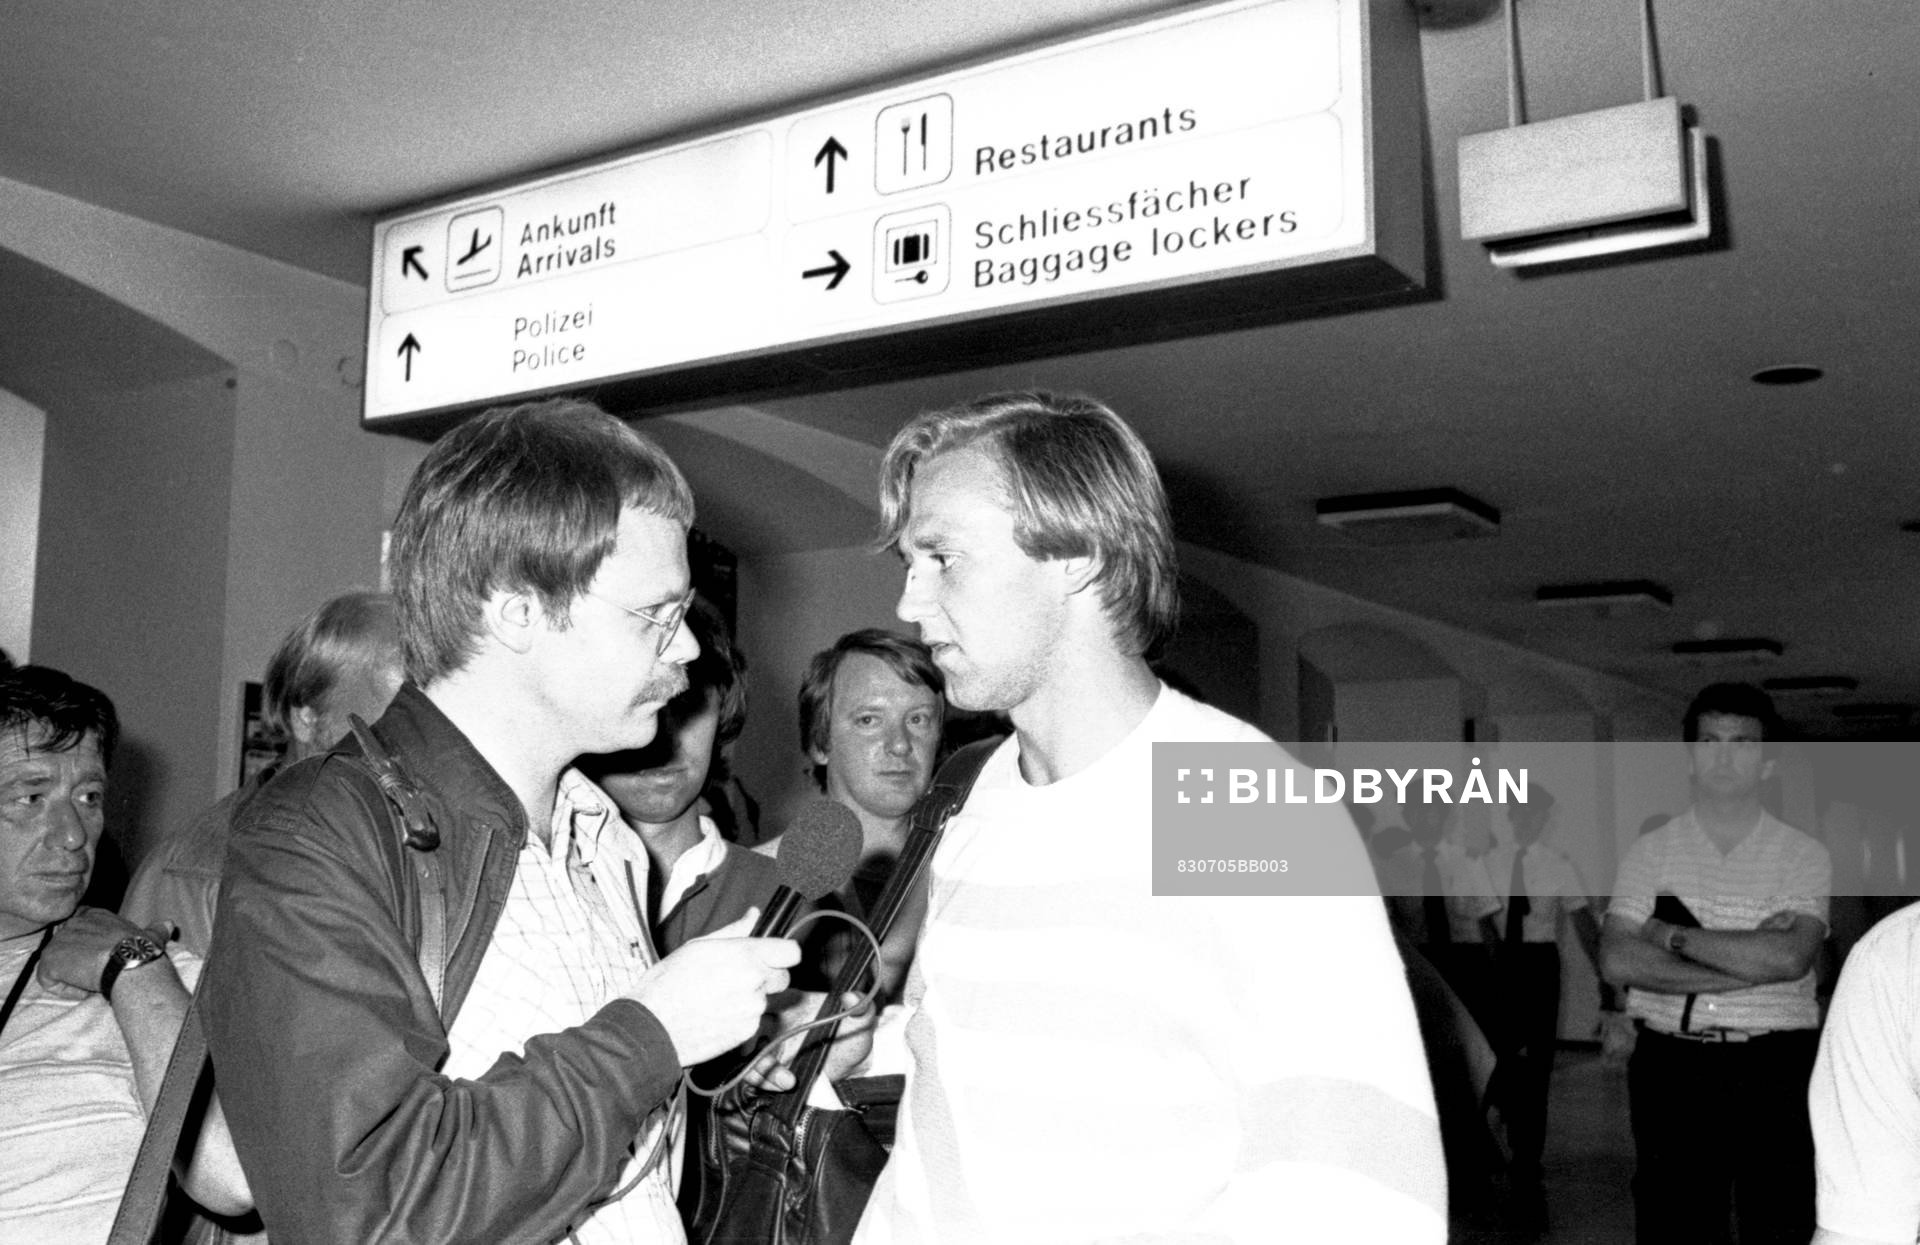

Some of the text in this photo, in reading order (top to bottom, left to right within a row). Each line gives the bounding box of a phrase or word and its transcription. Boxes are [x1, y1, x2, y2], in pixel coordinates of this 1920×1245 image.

[975, 107, 1197, 176] Restaurants
[519, 202, 617, 247] Ankunft
[975, 177, 1251, 249] Schliessfächer
[516, 235, 616, 279] Arrivals
[974, 209, 1297, 288] Baggage lockers
[514, 303, 594, 341] Polizei
[512, 342, 586, 374] Police
